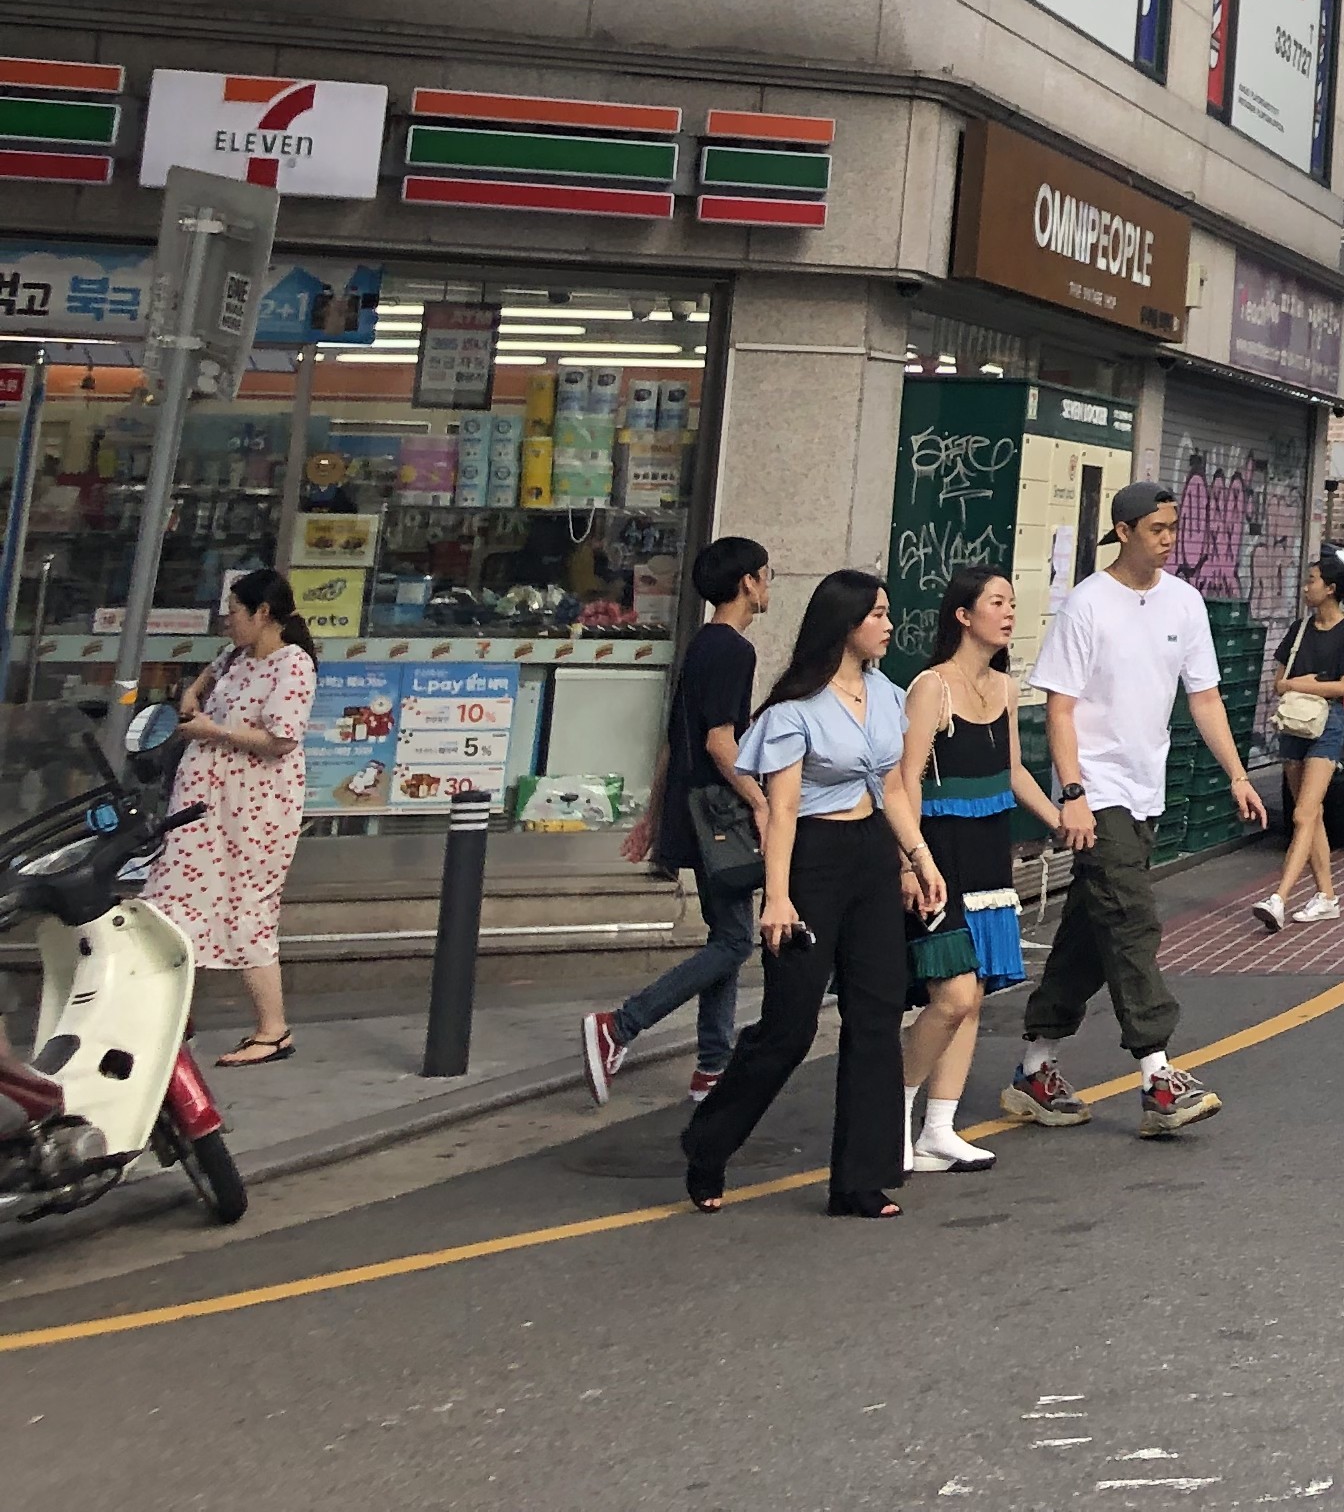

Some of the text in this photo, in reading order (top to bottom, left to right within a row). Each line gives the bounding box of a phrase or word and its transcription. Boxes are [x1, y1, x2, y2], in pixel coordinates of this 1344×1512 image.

[1275, 25, 1292, 63] 333
[1033, 182, 1155, 287] OMNIPEOPLE
[259, 292, 310, 322] 2+1
